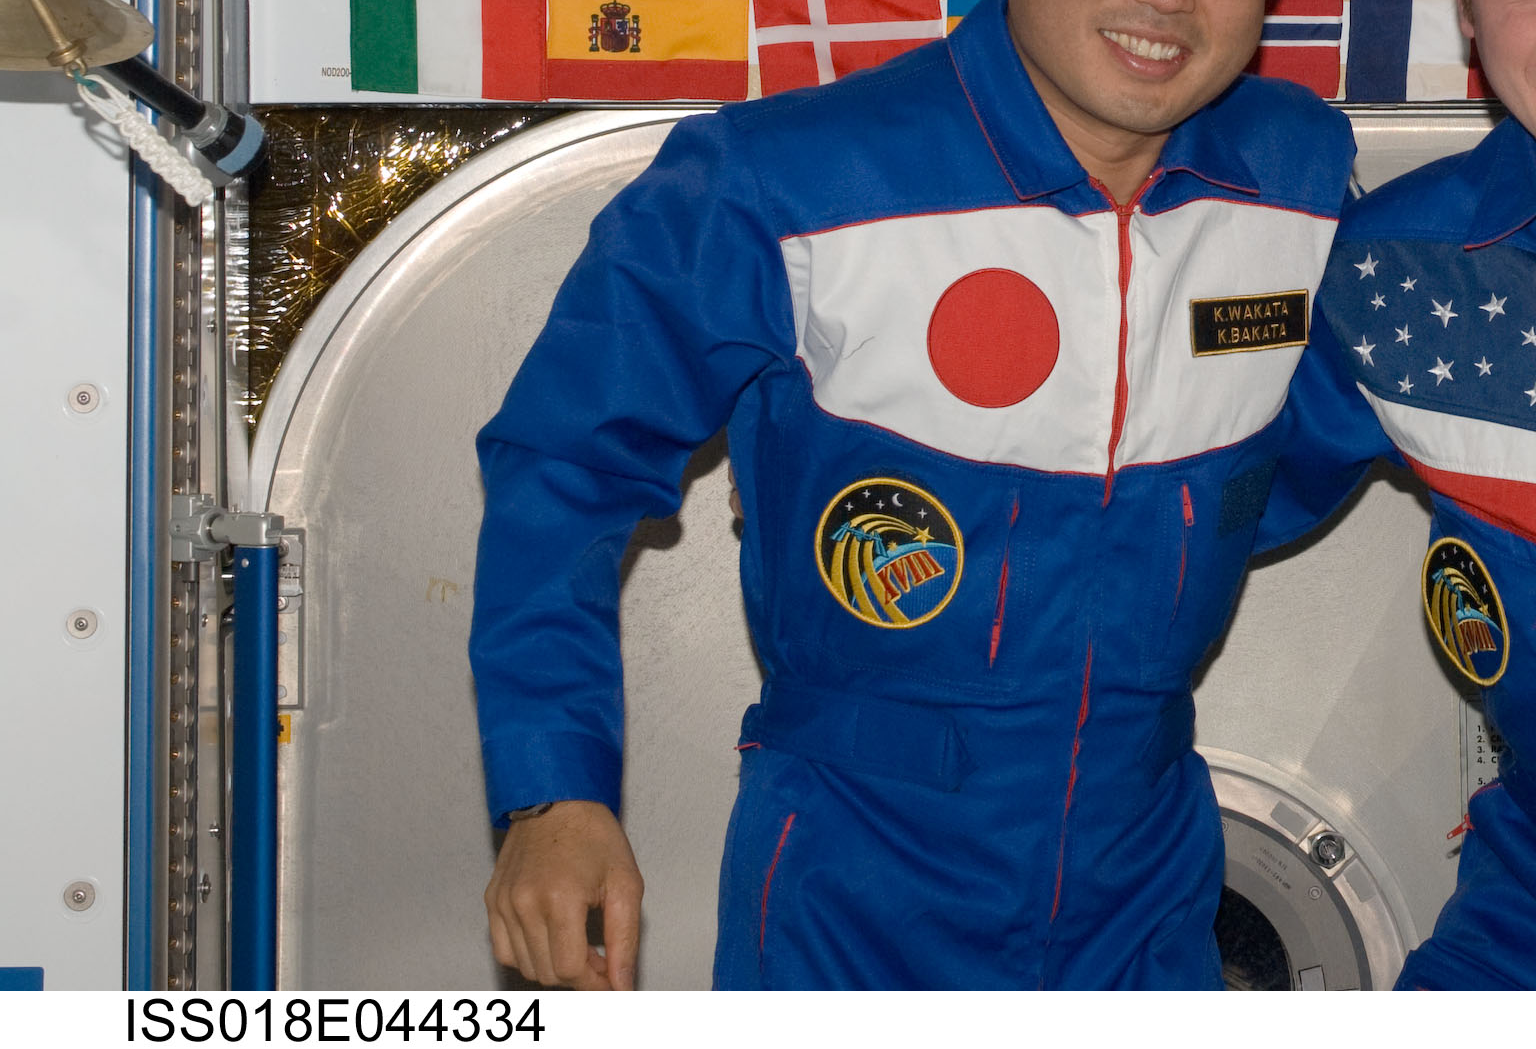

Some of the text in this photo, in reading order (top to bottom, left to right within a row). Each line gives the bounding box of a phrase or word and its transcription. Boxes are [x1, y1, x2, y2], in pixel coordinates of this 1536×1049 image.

[1213, 300, 1289, 323] K.WAKATA
[1217, 322, 1287, 345] K.BAKATA
[876, 549, 946, 606] XVIII
[1477, 725, 1485, 733] 1.
[1476, 735, 1486, 743] 2.
[1477, 745, 1486, 754] 3.
[1477, 756, 1486, 764] 4.
[1477, 777, 1486, 785] 5.
